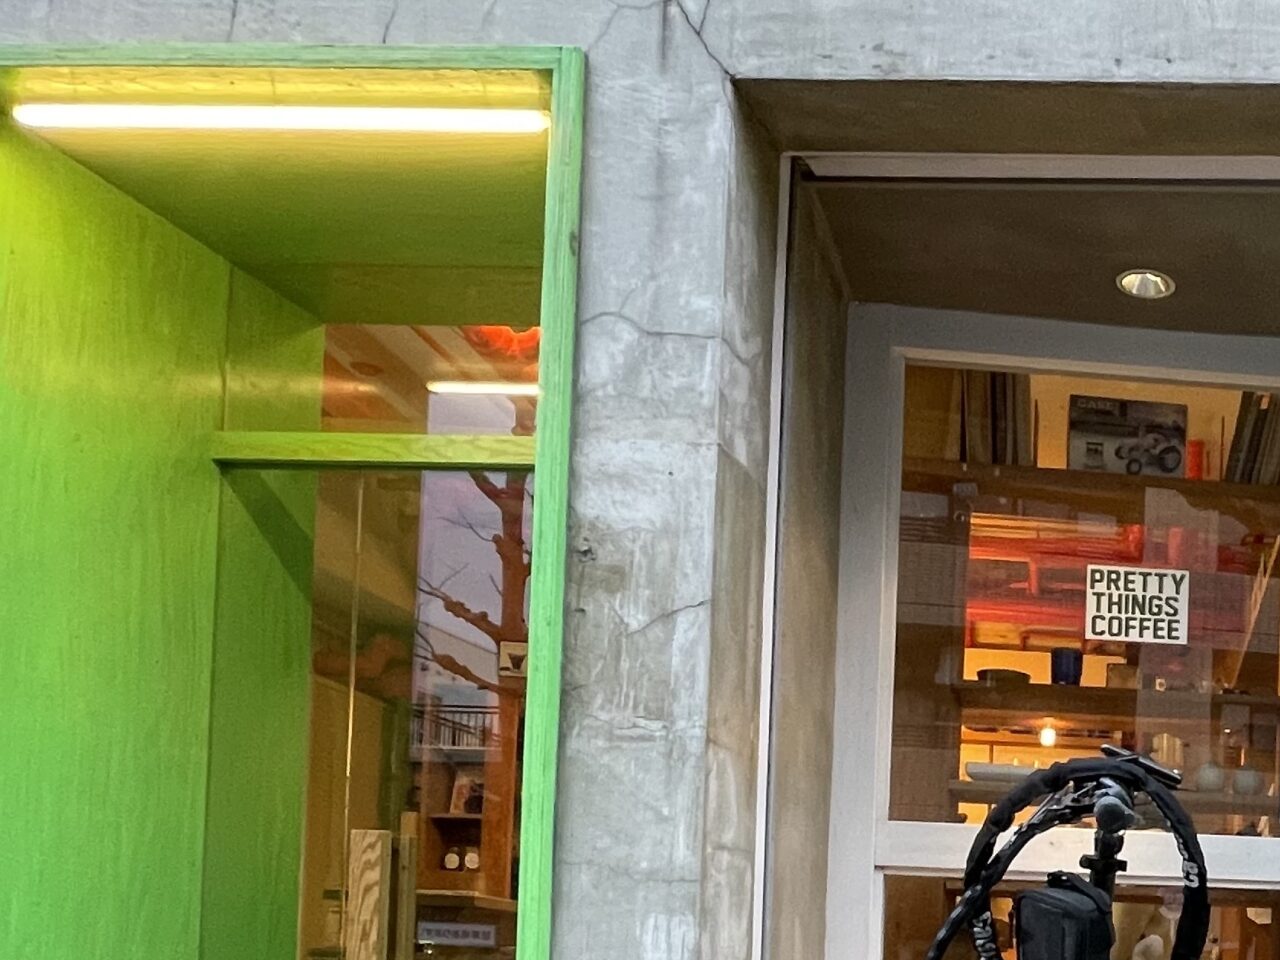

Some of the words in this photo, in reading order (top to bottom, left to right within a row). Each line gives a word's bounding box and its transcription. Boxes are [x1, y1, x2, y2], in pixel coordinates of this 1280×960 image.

[1089, 568, 1186, 595] PRETTY
[1091, 592, 1180, 617] THINGS
[1091, 614, 1180, 640] COFFEE
